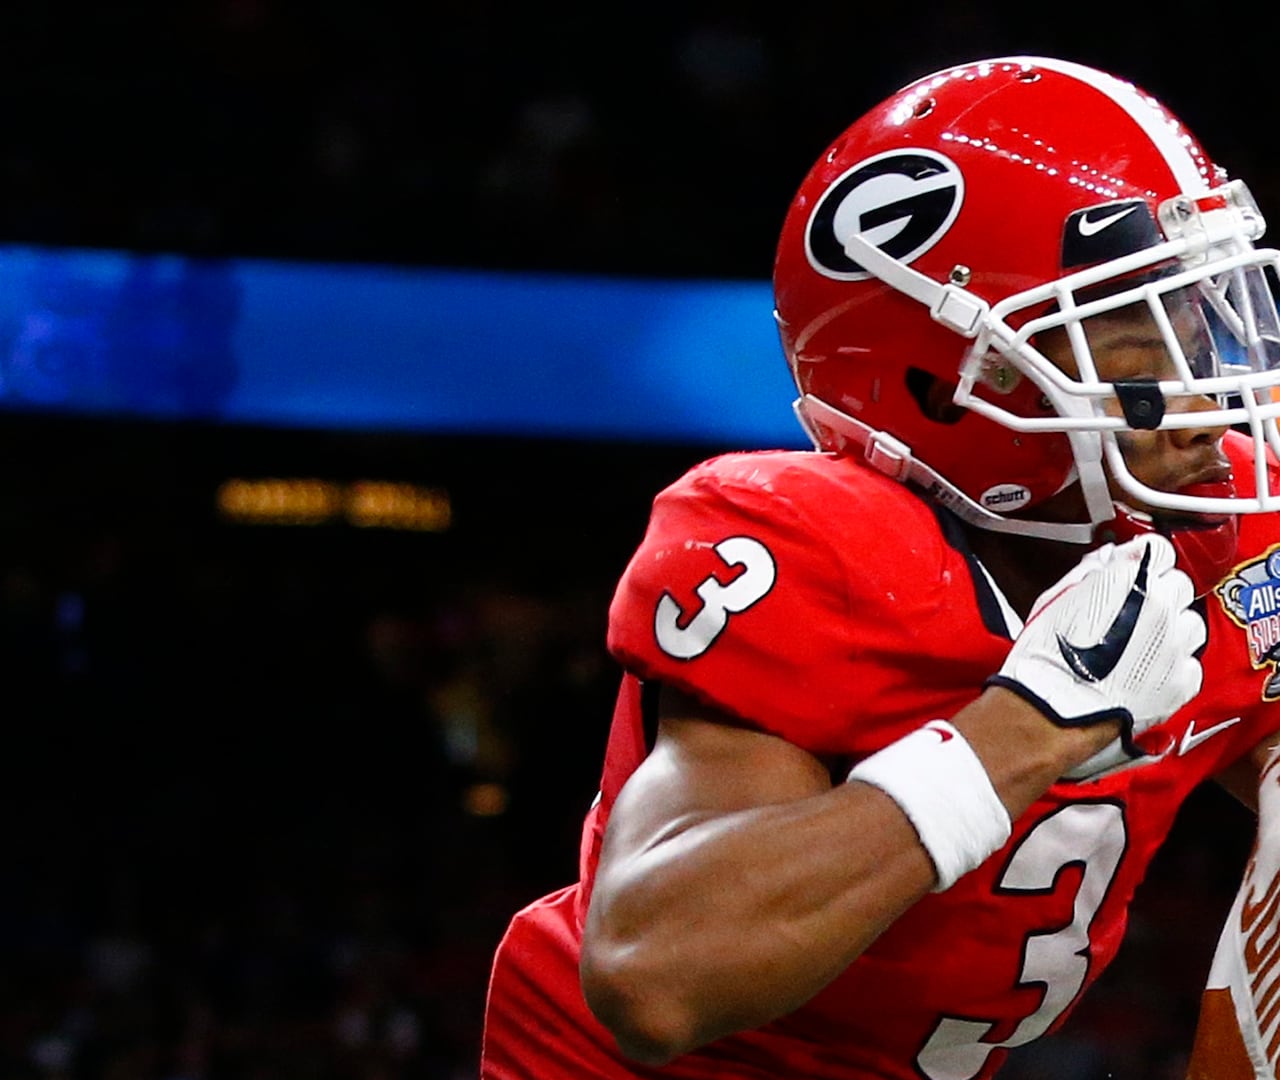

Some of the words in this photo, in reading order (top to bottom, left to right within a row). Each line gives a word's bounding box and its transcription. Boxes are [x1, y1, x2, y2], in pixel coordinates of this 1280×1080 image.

[808, 153, 958, 274] G
[984, 489, 1025, 506] schutt
[654, 535, 777, 661] 3
